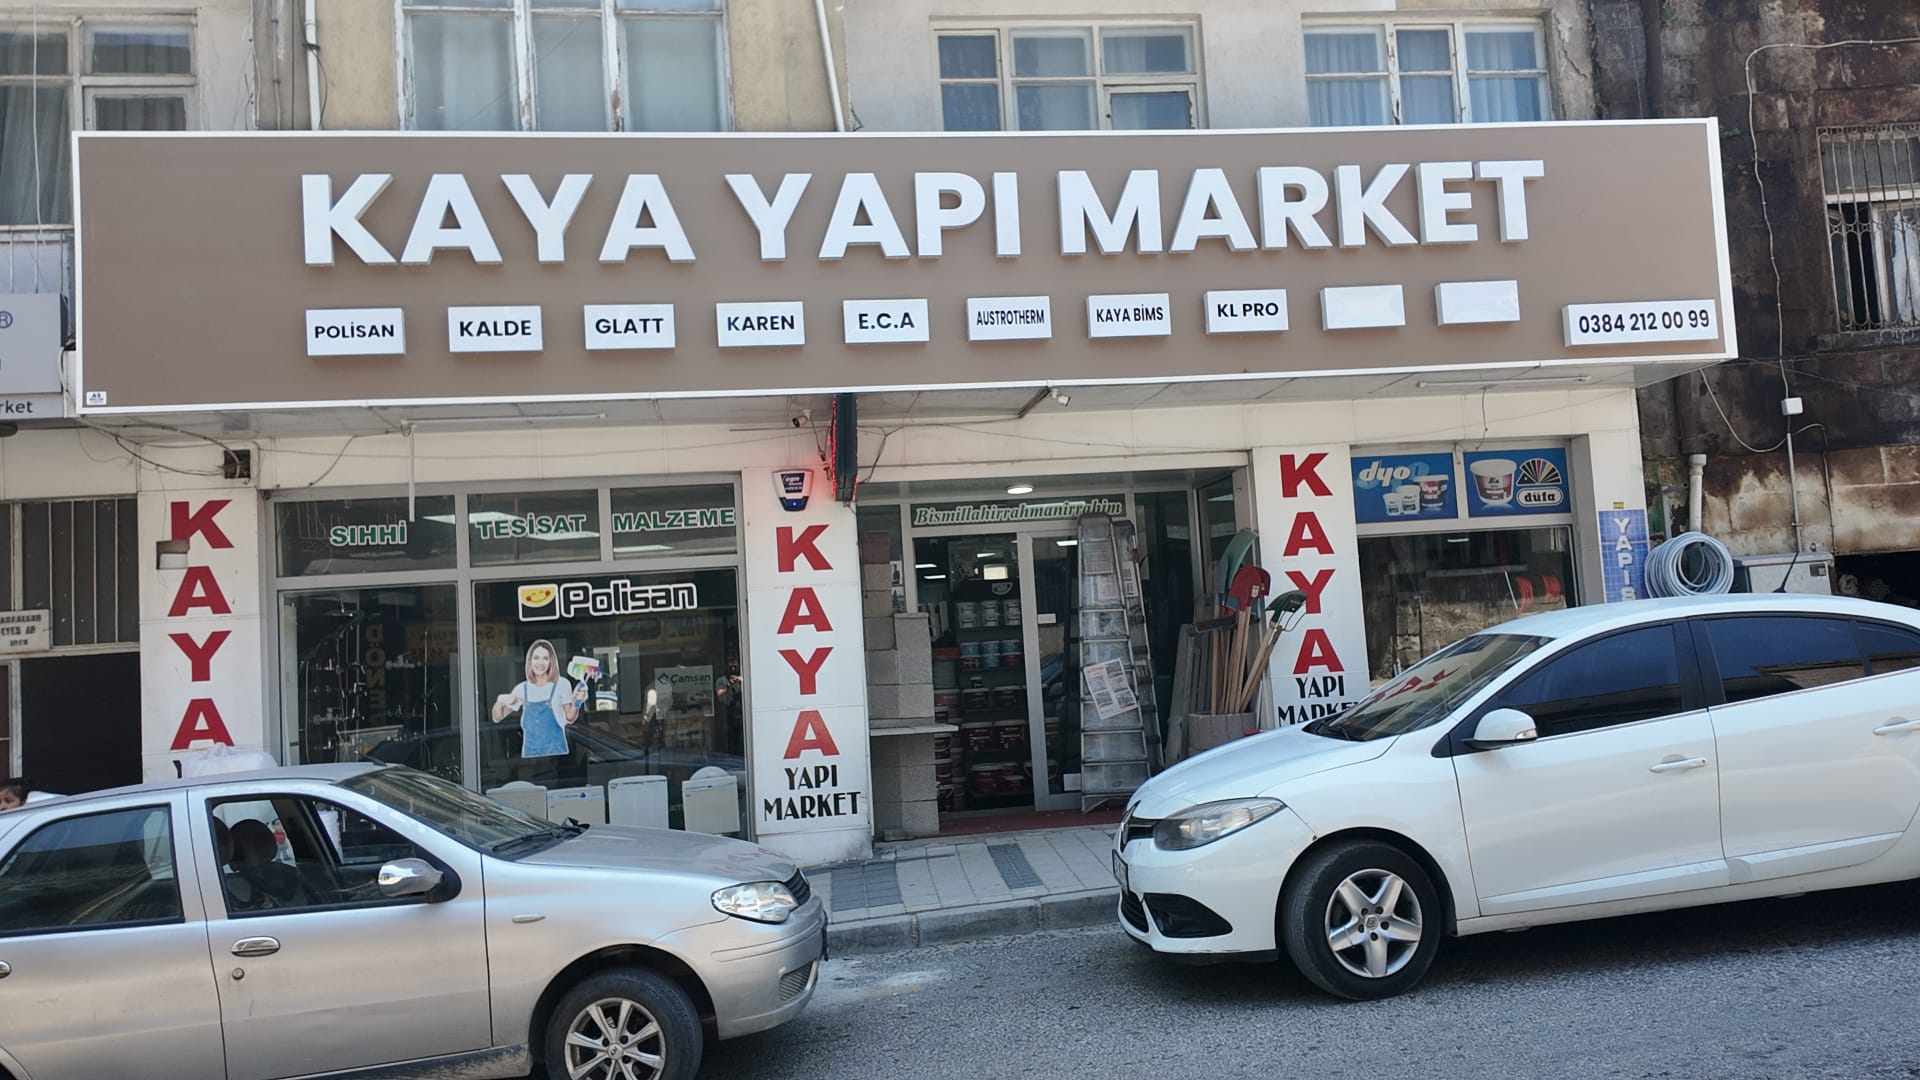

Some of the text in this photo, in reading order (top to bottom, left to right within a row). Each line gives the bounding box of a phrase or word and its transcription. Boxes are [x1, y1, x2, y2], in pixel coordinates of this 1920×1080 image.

[302, 160, 1544, 266] KAYA YAPI MARKET
[858, 312, 915, 330] E.C.A
[976, 310, 1045, 325] AUSTROTHERM
[1096, 304, 1164, 323] KAYA BİMS
[1217, 302, 1279, 318] KL PRO
[1579, 309, 1710, 334] 0384 212 00 99
[314, 321, 395, 339] POLİSAN
[459, 320, 532, 337] KALDE
[595, 318, 664, 334] GLATT
[727, 315, 795, 331] KAREN
[1358, 460, 1412, 487] dyo
[1524, 491, 1556, 504] düfa
[330, 507, 736, 546] SIHHİ TESİSAT MALZEME
[1280, 452, 1346, 675] KAYA
[561, 579, 698, 617] Polisan
[168, 499, 235, 751] KAYA
[776, 524, 840, 760] KAYA
[1296, 675, 1345, 699] YAPI
[784, 764, 839, 791] YAPI
[764, 791, 862, 822] MARKET
